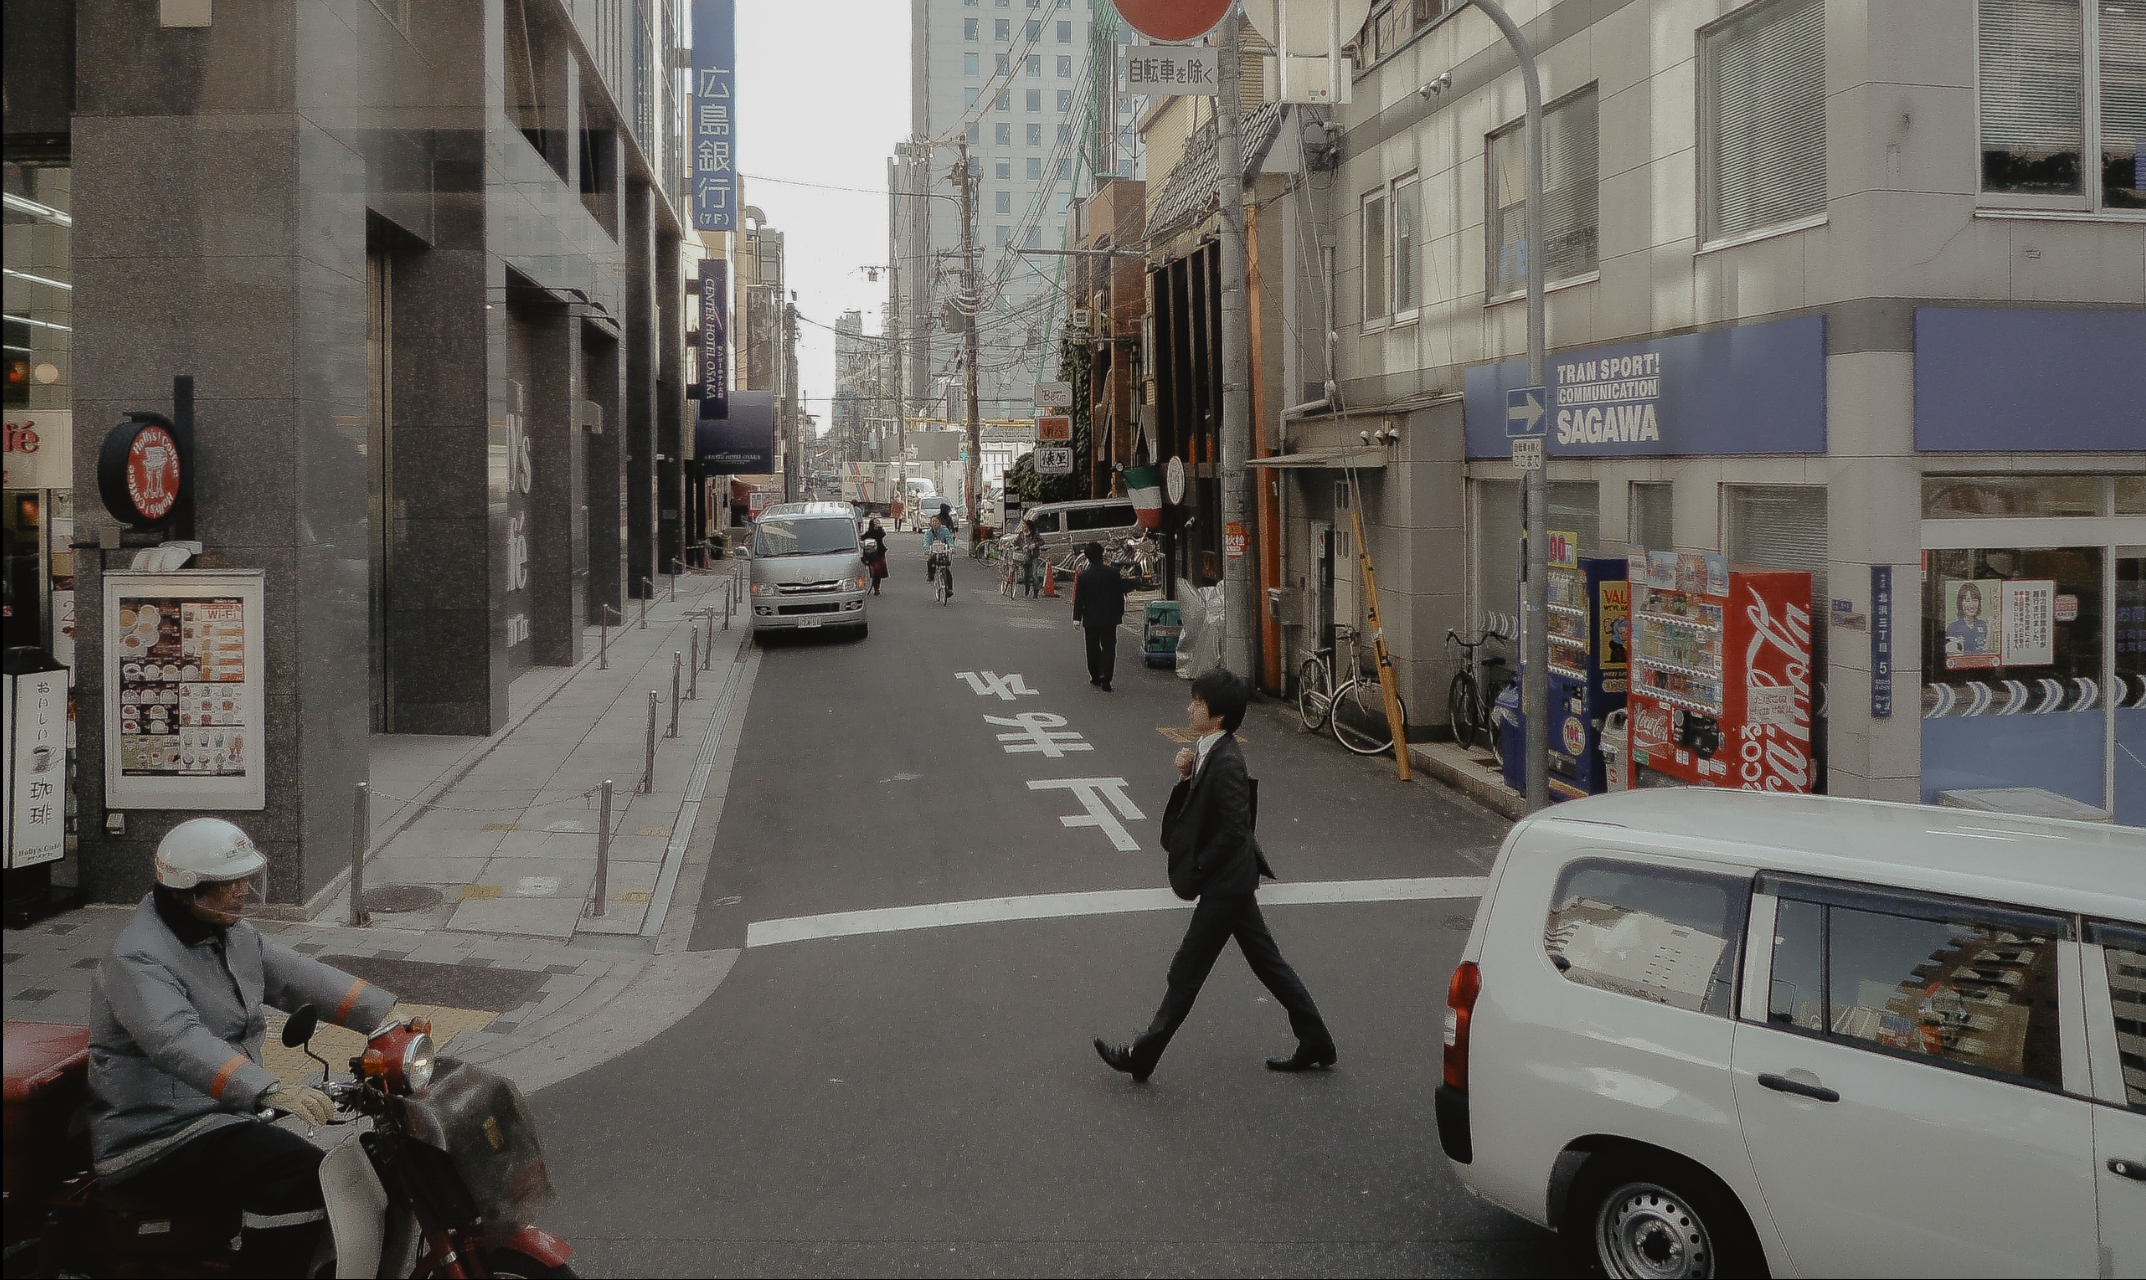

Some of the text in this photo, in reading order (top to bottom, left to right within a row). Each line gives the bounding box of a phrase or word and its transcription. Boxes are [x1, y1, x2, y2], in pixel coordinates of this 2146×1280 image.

[1129, 57, 1213, 84] 自転車を除く
[698, 66, 731, 209] 広島銀行
[699, 213, 730, 226] (7F)
[705, 278, 717, 400] CENTER HOTEL OSAKA
[1557, 353, 1660, 384] TRAN SPORT!
[1560, 380, 1658, 403] COMMUNICATION
[1557, 404, 1660, 445] SAGAWA
[1514, 455, 1540, 467] ここまで
[1602, 588, 1627, 604] VAL
[207, 609, 237, 620] Wi-Fi
[1877, 593, 1888, 652] 北浜三丁目
[1879, 661, 1888, 674] 5
[29, 681, 54, 826] おいしい 珈琲
